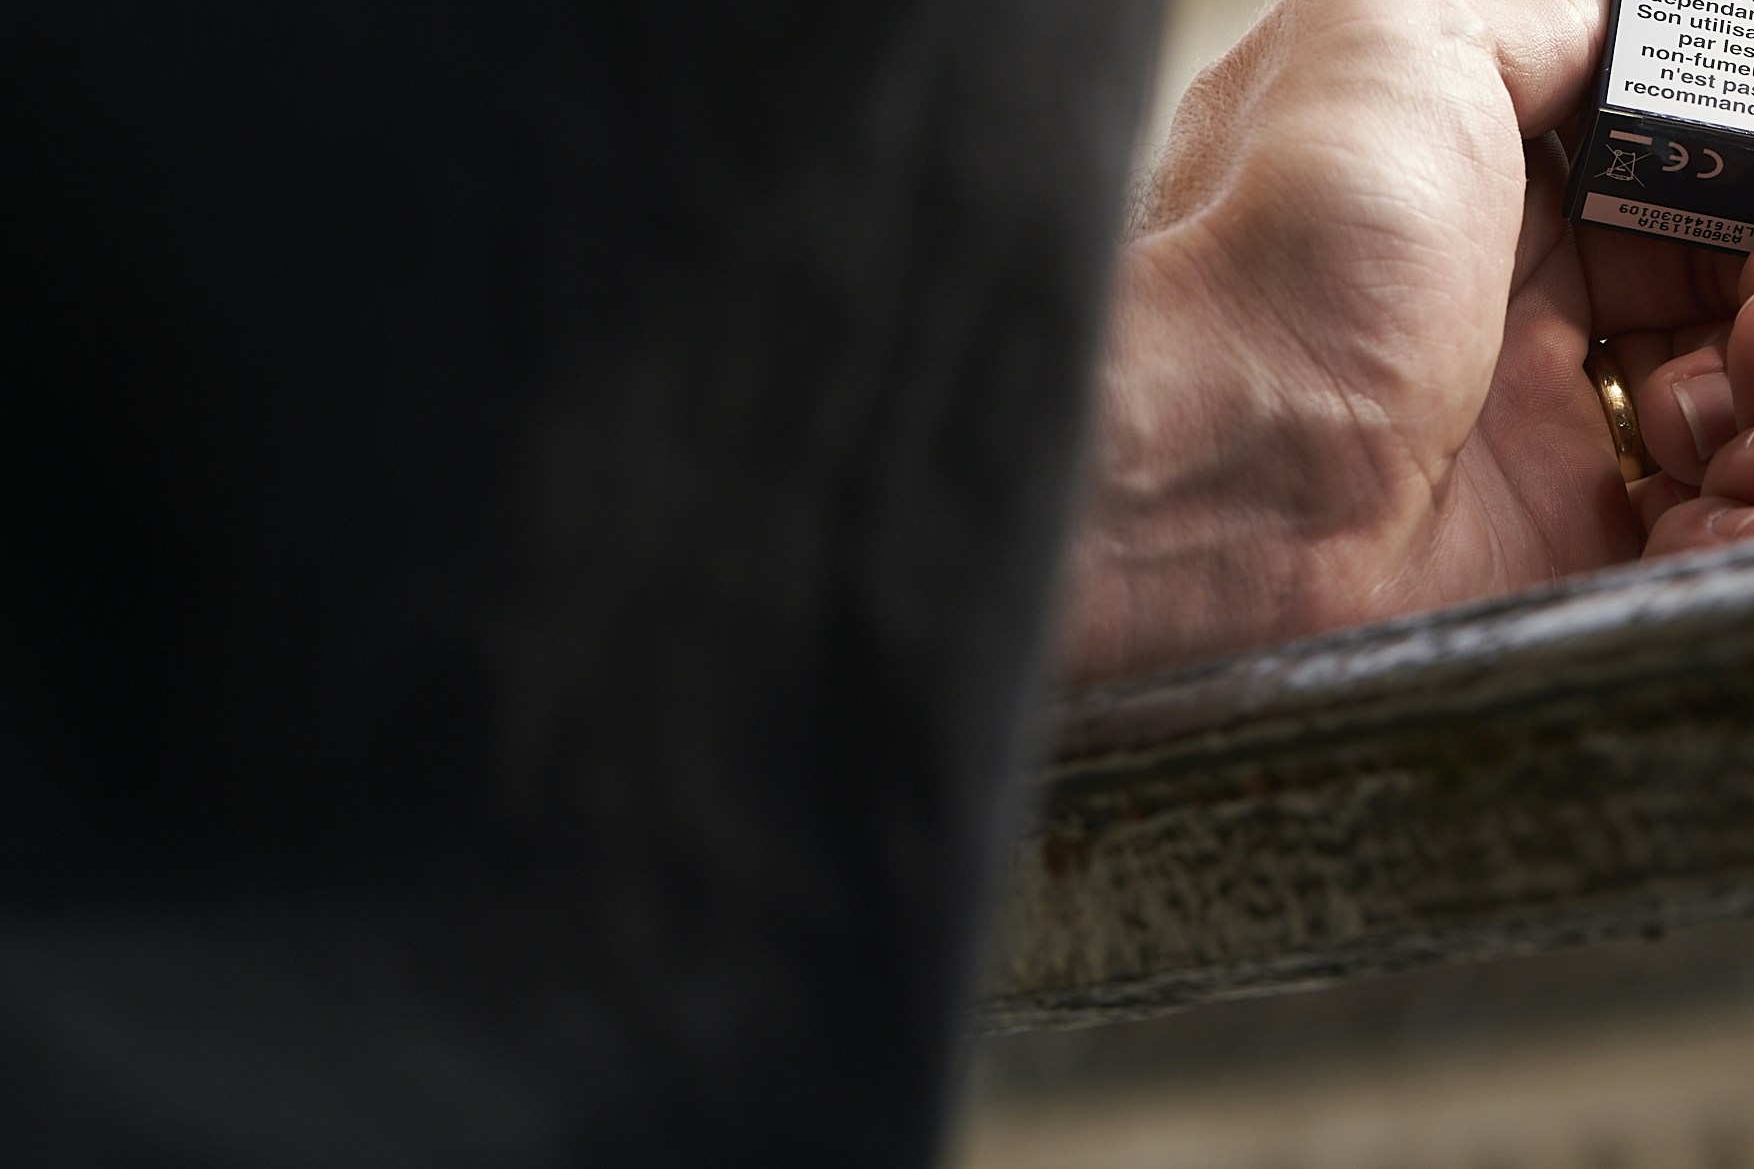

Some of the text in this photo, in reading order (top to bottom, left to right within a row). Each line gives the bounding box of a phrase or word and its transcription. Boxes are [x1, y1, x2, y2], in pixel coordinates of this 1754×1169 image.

[1637, 4, 1682, 24] Son
[1678, 34, 1716, 50] par
[1660, 67, 1716, 88] n'est
